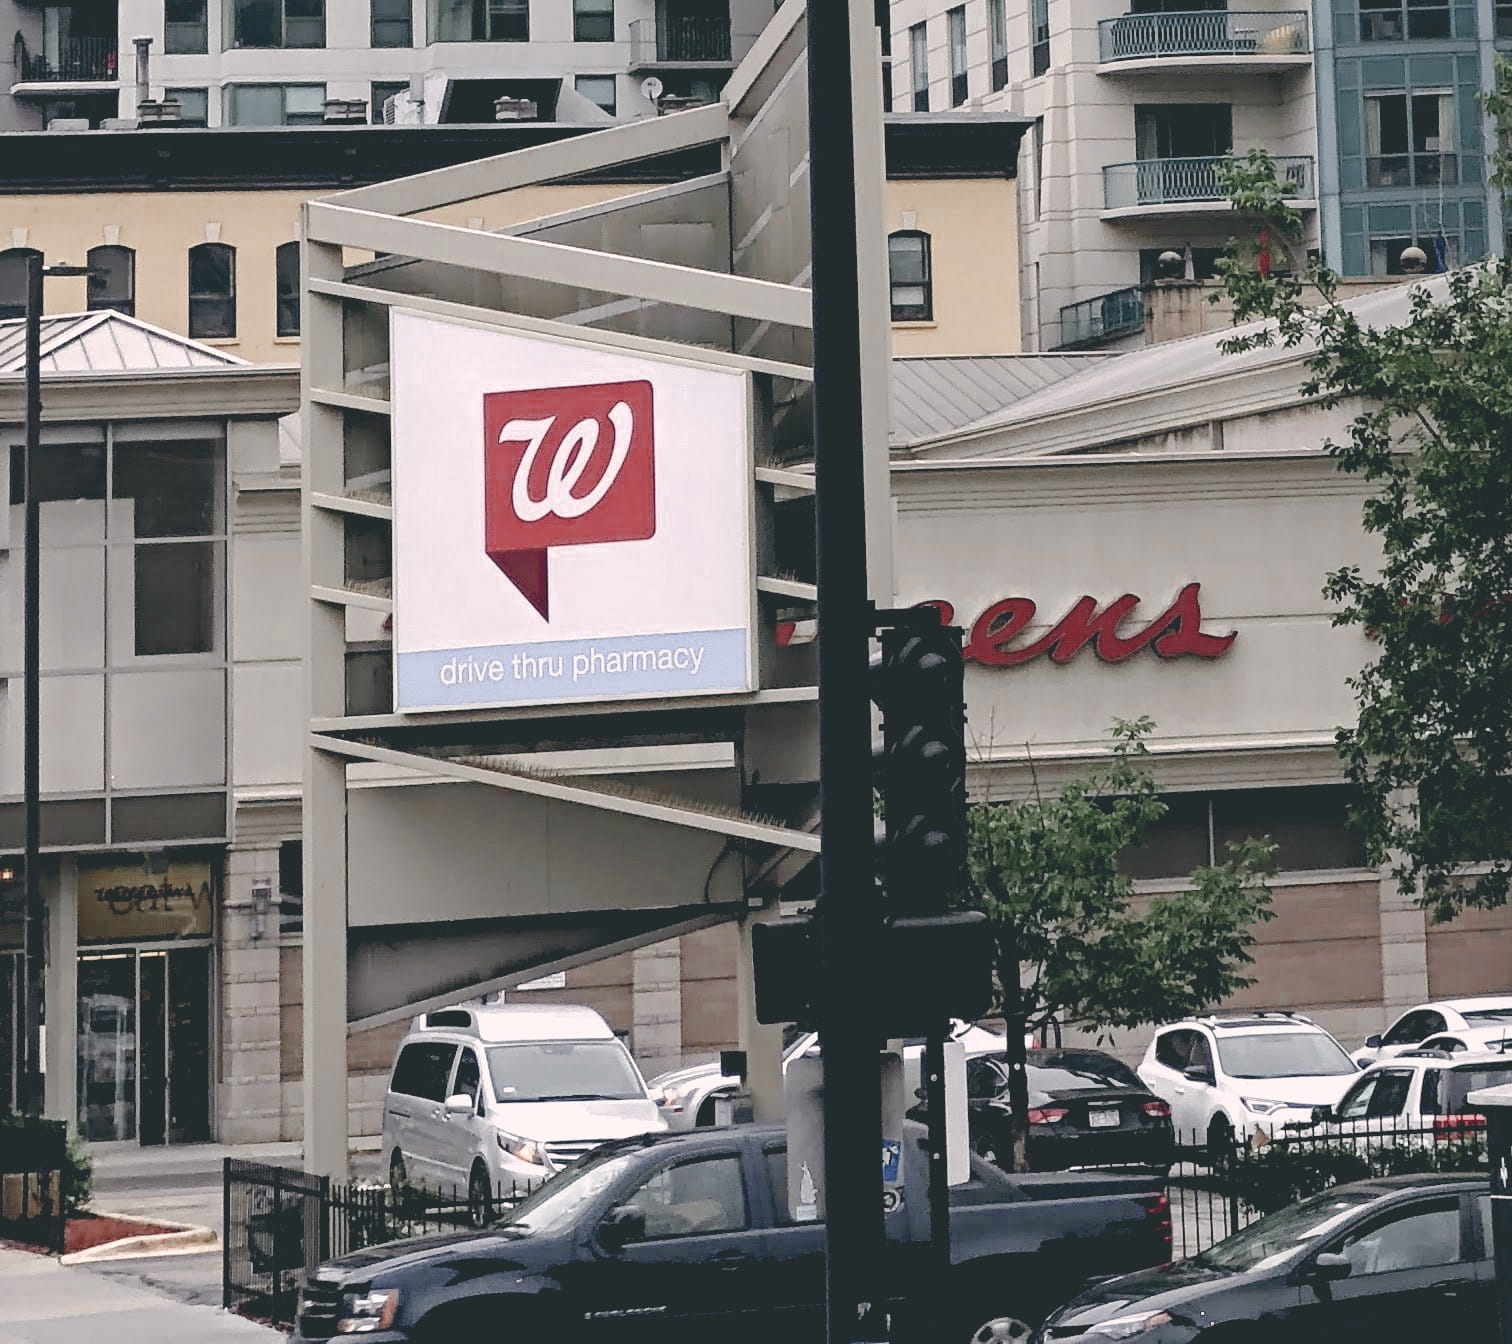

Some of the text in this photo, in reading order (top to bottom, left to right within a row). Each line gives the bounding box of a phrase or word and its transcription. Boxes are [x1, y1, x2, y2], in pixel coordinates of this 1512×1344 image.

[440, 645, 706, 686] drive thru pharmacy
